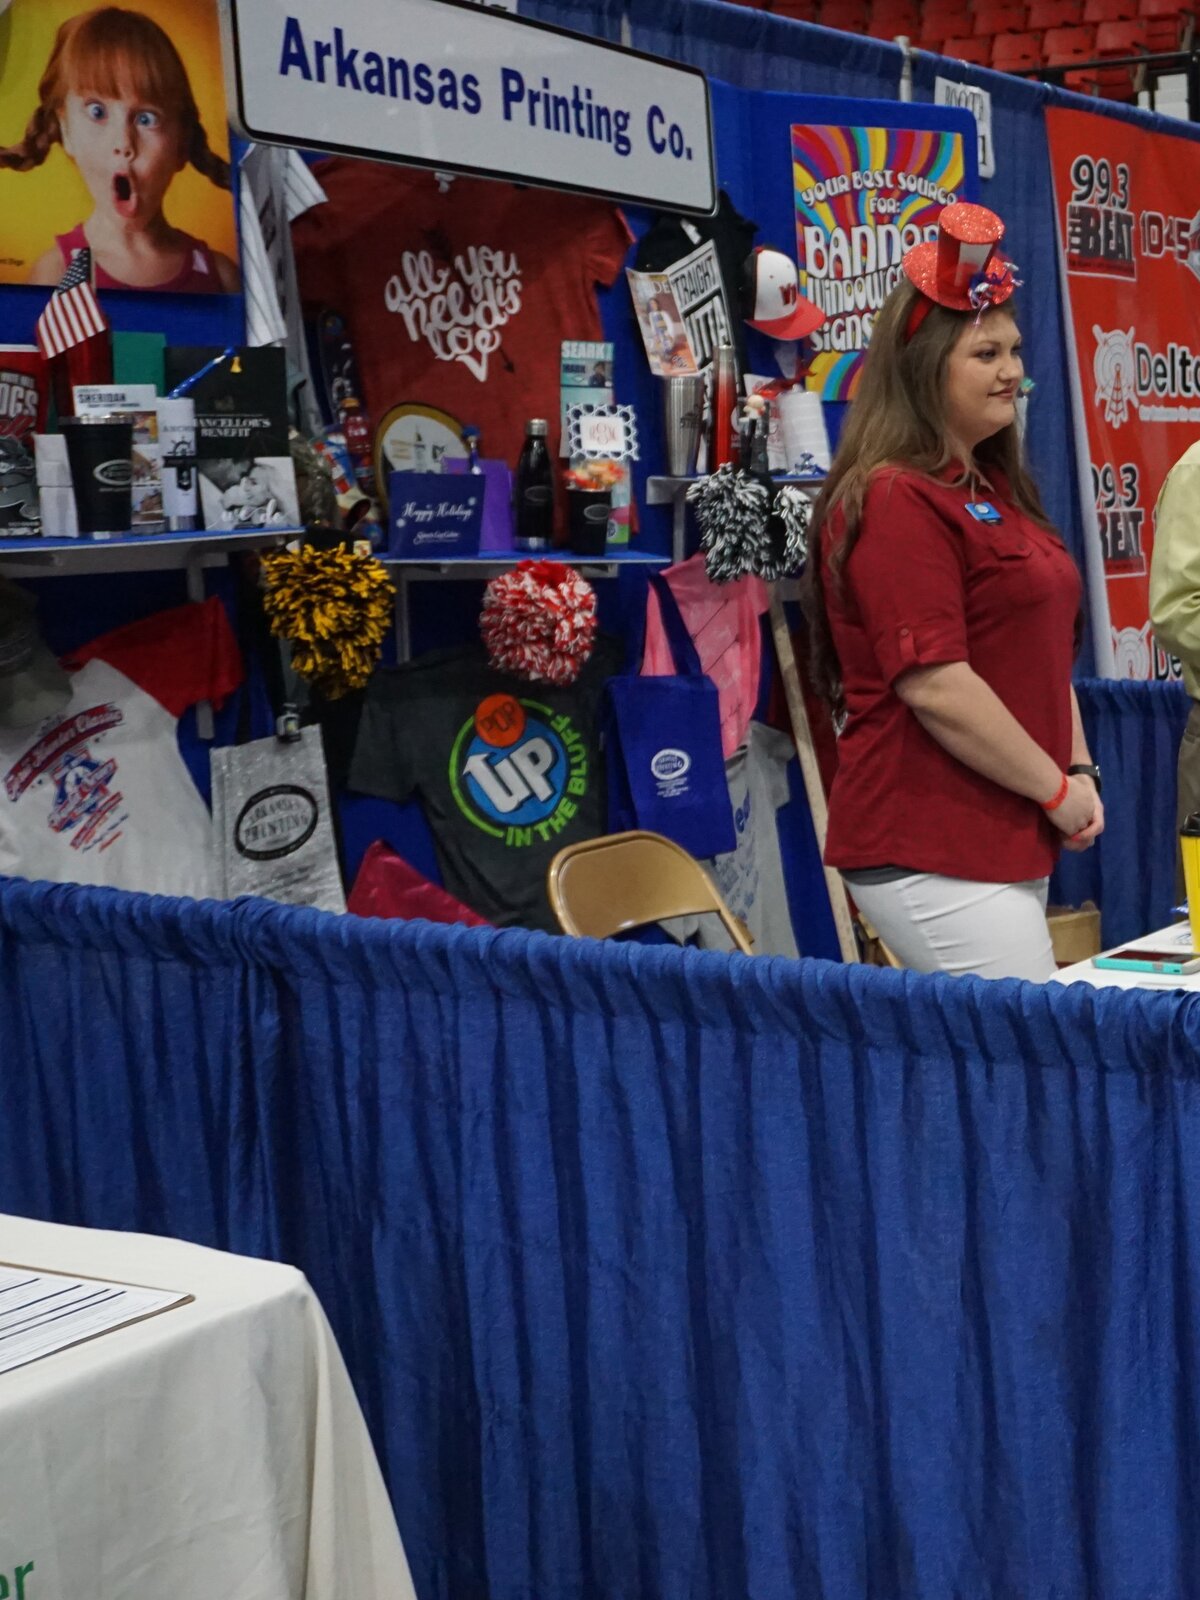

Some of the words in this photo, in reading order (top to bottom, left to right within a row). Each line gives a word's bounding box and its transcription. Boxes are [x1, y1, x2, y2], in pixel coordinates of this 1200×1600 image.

[279, 16, 482, 115] Arkansas
[501, 66, 632, 157] Printing
[646, 105, 693, 160] Co.
[801, 173, 850, 206] YOUR
[852, 169, 895, 191] BEST
[897, 171, 957, 206] SOURCE
[869, 196, 901, 214] FOR:
[1071, 155, 1129, 210] 99.3
[1080, 206, 1135, 262] BEAT
[385, 250, 450, 312] all
[455, 246, 522, 303] you
[672, 255, 714, 305] TRAIGHT
[398, 278, 508, 341] need
[495, 278, 522, 315] is
[684, 295, 730, 366] UTTA
[194, 417, 272, 429] ANCELLOR'S
[201, 427, 252, 438] BENEFIT
[478, 701, 518, 733] POP
[463, 737, 555, 814] UP
[551, 714, 588, 796] BLUFF
[505, 826, 533, 848] IN
[534, 796, 579, 842] THE
